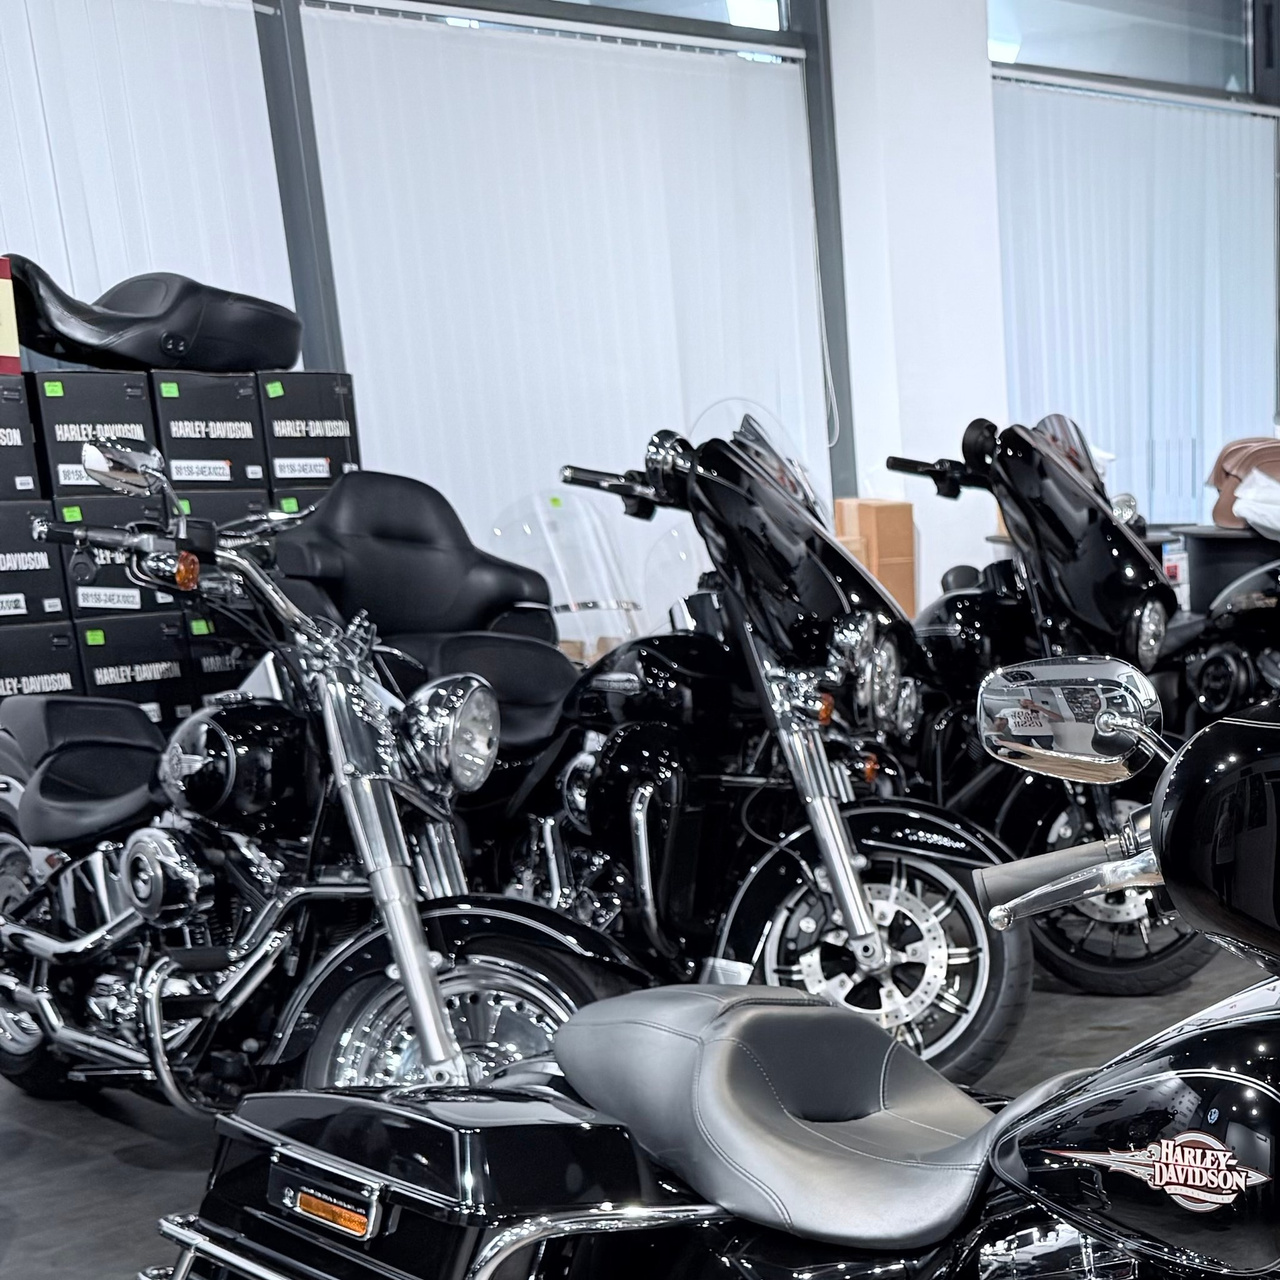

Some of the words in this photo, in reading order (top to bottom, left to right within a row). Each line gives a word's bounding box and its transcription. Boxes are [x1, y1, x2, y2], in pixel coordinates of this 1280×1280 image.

[169, 420, 254, 439] HARLEY-DAVIDSON
[272, 419, 351, 437] HARLEY-DAVIDSON
[93, 661, 182, 686] HARLEY-DAVIDSON
[1160, 1139, 1239, 1170] HARLEY-
[1153, 1161, 1248, 1193] DAVIDSON
